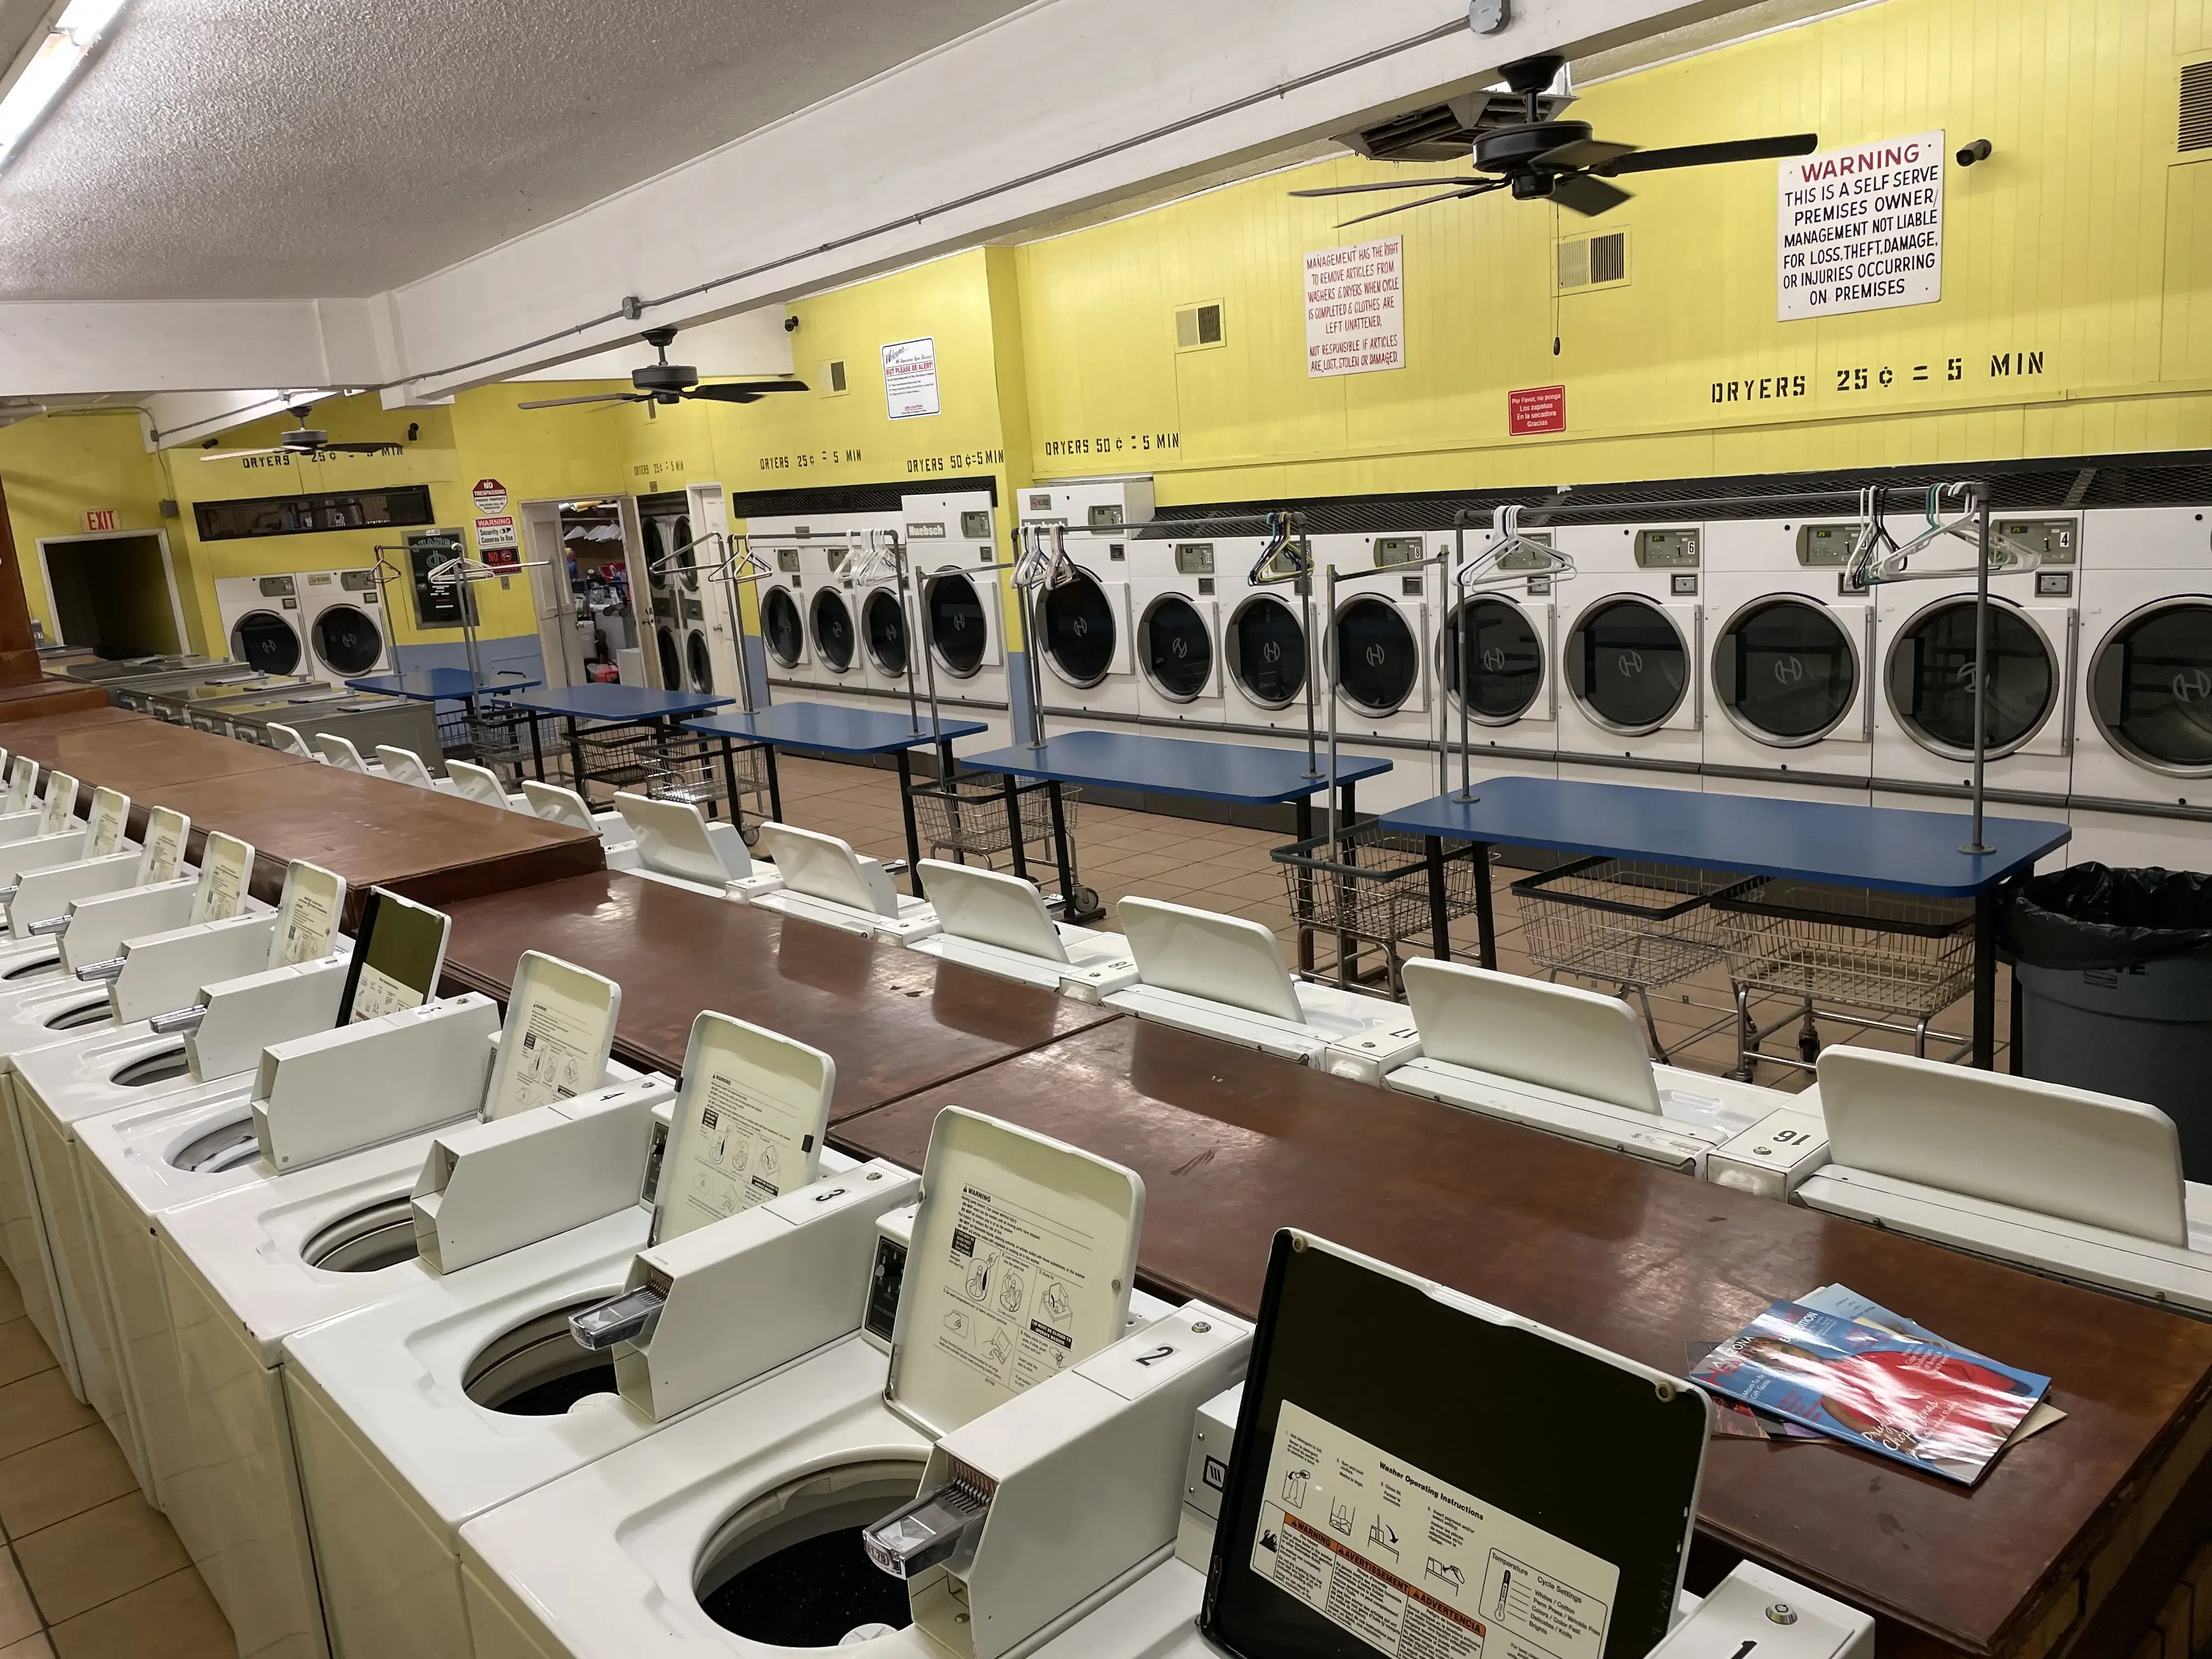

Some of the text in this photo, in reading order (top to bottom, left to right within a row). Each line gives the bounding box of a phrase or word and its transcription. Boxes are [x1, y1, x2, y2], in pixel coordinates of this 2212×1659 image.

[1801, 143, 1919, 182] WARNING
[1785, 165, 1938, 207] THIS IS A SELF SERVE
[1795, 188, 1938, 225] PREMISES OWNER/
[1784, 210, 1937, 247] MANAGEMENT NOT LIABLE
[1307, 242, 1398, 270] MANAGEMENT HAS THE RIGHT
[1784, 255, 1804, 269] FOR
[1312, 261, 1394, 285] TO REMOVE ARTICLES FROM
[1783, 253, 1935, 289] OR INJURIES OCCURRING
[1308, 278, 1399, 303] WASHERS & DRYERS WHEN CYCLE
[1810, 279, 1905, 305] ON PREMISES
[1309, 296, 1395, 320] IS COMPLETED & CLOTHES ARE
[1326, 320, 1342, 334] LEFT
[1310, 335, 1398, 357] NOT RESPONSIBLE IF ARTICLES
[1311, 351, 1398, 372] ARE LOST, STOLEN OR DAMAGED.
[1712, 376, 1805, 403] DRYERS
[1912, 365, 1928, 380] =
[1948, 358, 1961, 380] 5
[1990, 352, 2044, 377] MIN
[1046, 439, 1089, 455] DRYERS
[1143, 436, 1150, 449] 5
[1156, 433, 1179, 449] MIN
[242, 455, 290, 468] DRYERS
[634, 465, 649, 476] DRYERS
[671, 461, 674, 471] 5
[760, 456, 789, 470] DRYERS
[833, 451, 838, 463] 5
[846, 449, 862, 462] MIN
[907, 458, 943, 472] DRYERS
[986, 449, 1004, 464] MIN
[87, 511, 114, 531] EXIT
[478, 518, 511, 527] WARNING
[909, 525, 943, 535] Huebsch
[1689, 542, 1694, 553] 6
[2061, 533, 2068, 546] 4
[488, 552, 498, 562] NO
[1206, 554, 1211, 562] 10
[1416, 548, 1419, 557] 8
[1108, 961, 1134, 975] 18
[600, 1092, 625, 1101] 4
[1773, 1130, 1812, 1146] 16
[815, 1189, 845, 1203] 3
[968, 1187, 991, 1203] WARNING
[1035, 1327, 1050, 1338] OPERATE
[1052, 1330, 1066, 1340] CLOSED
[1136, 1346, 1173, 1366] 2
[1742, 1373, 1766, 1396] Mom-To-Be
[1379, 1461, 1403, 1480] Washer
[1404, 1474, 1438, 1498] Operating
[1440, 1493, 1483, 1521] Instructions
[1296, 1521, 1331, 1547] WARNING
[1344, 1550, 1409, 1593] AVERTISSEMENT
[1491, 1552, 1528, 1577] Temperature
[1537, 1576, 1582, 1605] Cycle Settings
[1419, 1593, 1481, 1633] ADVERTENCIA
[1534, 1589, 1552, 1603] Whites
[1556, 1601, 1575, 1615] Cotton
[1528, 1621, 1547, 1635] Brights
[1530, 1613, 1554, 1629] Delicates
[1559, 1628, 1572, 1639] Knits
[1531, 1605, 1549, 1618] Colors
[1553, 1616, 1568, 1629] Color
[1568, 1624, 1581, 1635] Fast
[1533, 1598, 1547, 1609] Perm
[1548, 1605, 1563, 1617] Press
[1567, 1615, 1587, 1629] Wrinkle
[1588, 1626, 1600, 1637] Free
